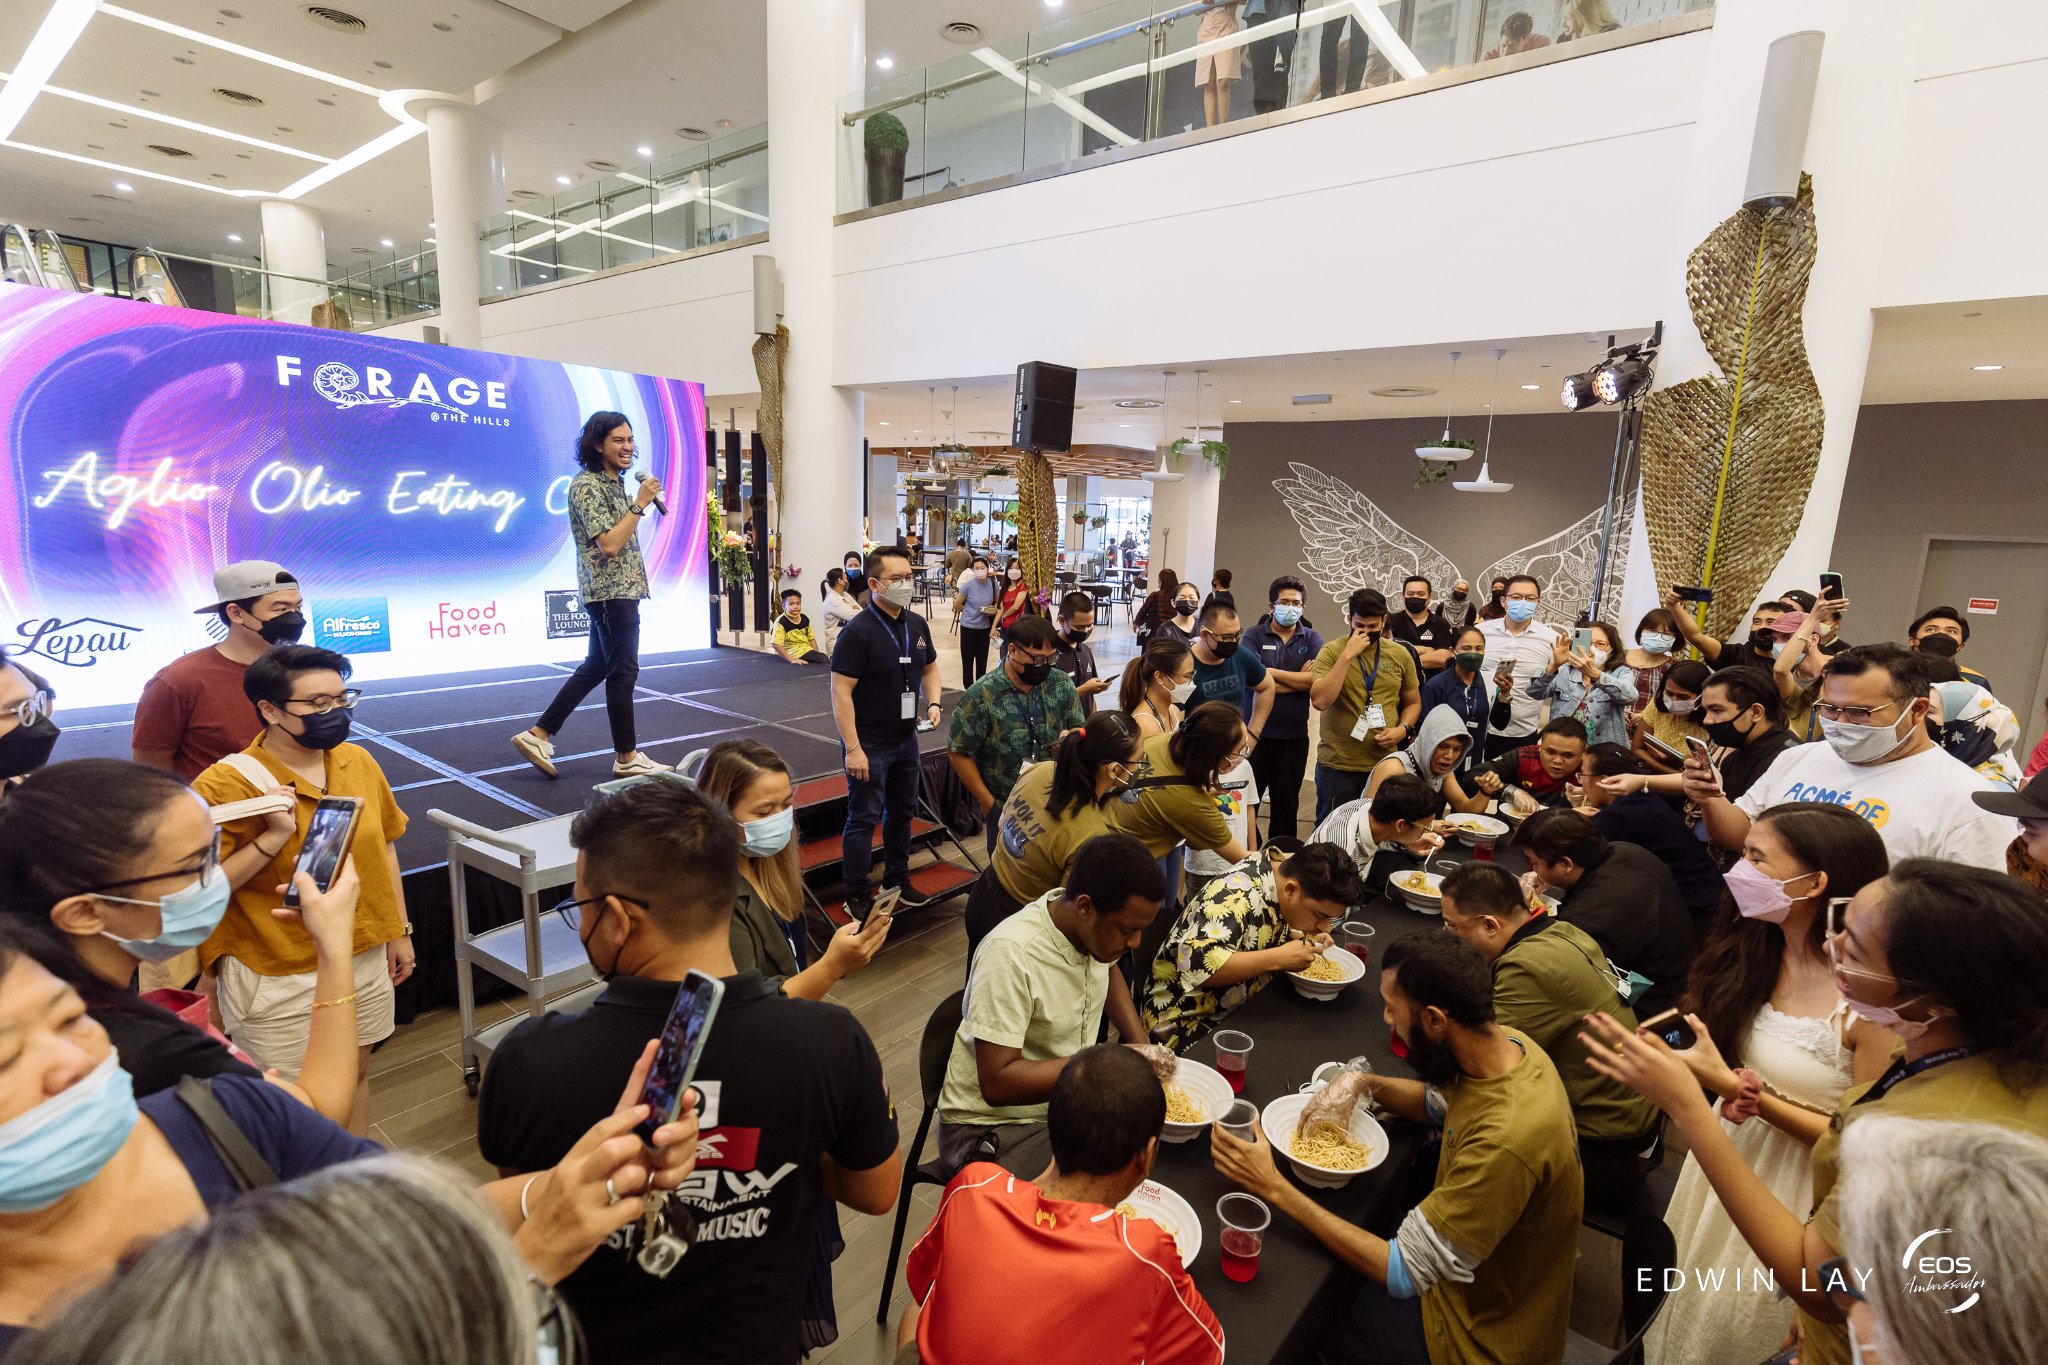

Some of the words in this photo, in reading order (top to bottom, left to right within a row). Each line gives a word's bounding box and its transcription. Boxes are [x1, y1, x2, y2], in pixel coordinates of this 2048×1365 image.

[430, 412, 467, 423] @THE
[473, 416, 510, 427] HILLS
[34, 451, 219, 529] Aglio
[250, 461, 361, 514] Olio
[387, 470, 526, 533] Eating
[439, 600, 496, 621] Food
[552, 613, 570, 622] THE
[323, 617, 381, 633] Alfresco
[429, 620, 506, 639] Haven
[2, 617, 144, 667] Lepau
[1012, 794, 1035, 827] WOK
[1027, 822, 1046, 838] IT
[1141, 1182, 1160, 1195] Food
[696, 1206, 772, 1243] MUSIC
